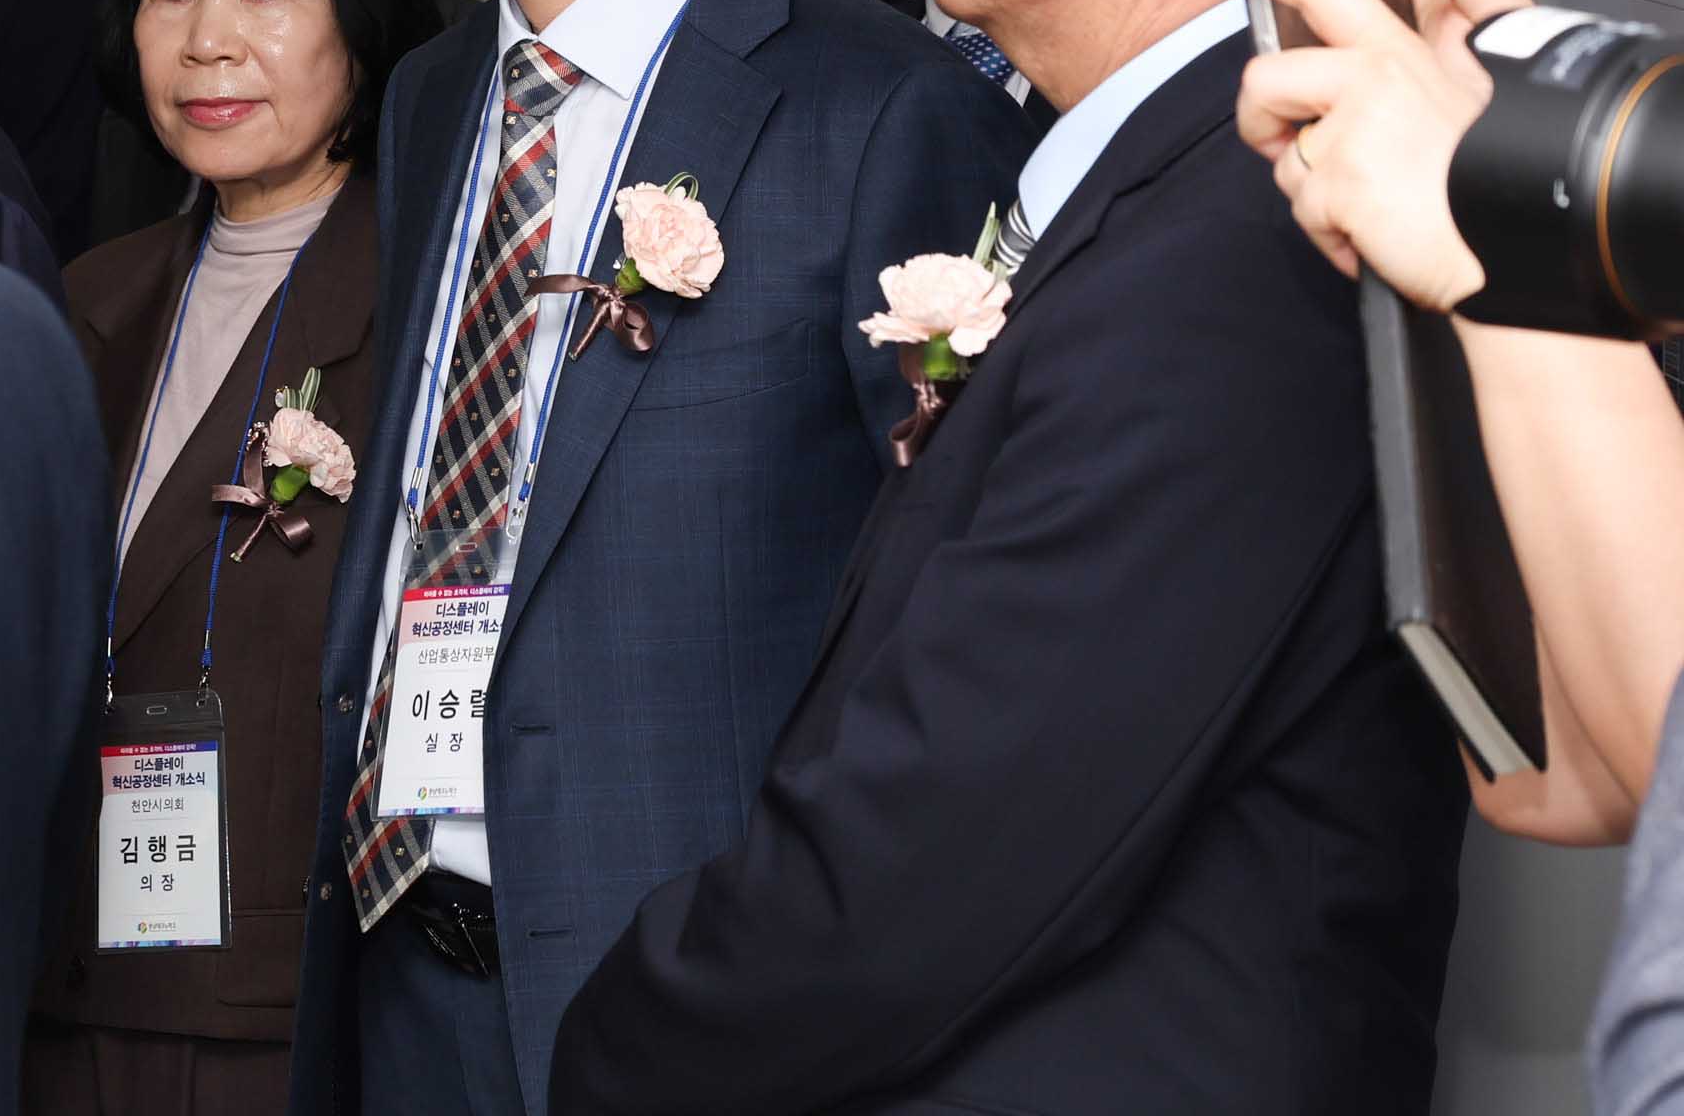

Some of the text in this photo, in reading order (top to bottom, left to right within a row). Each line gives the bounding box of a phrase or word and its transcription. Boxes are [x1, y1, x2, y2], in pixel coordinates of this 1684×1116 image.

[436, 601, 490, 617] 디스플레이
[412, 619, 503, 638] 혁신공정센터 개소
[418, 646, 495, 665] 산업통상자원부
[134, 756, 184, 772] 디스플레이
[112, 771, 205, 789] 혁신공정센터 개소식
[131, 796, 185, 813] 천안시의회
